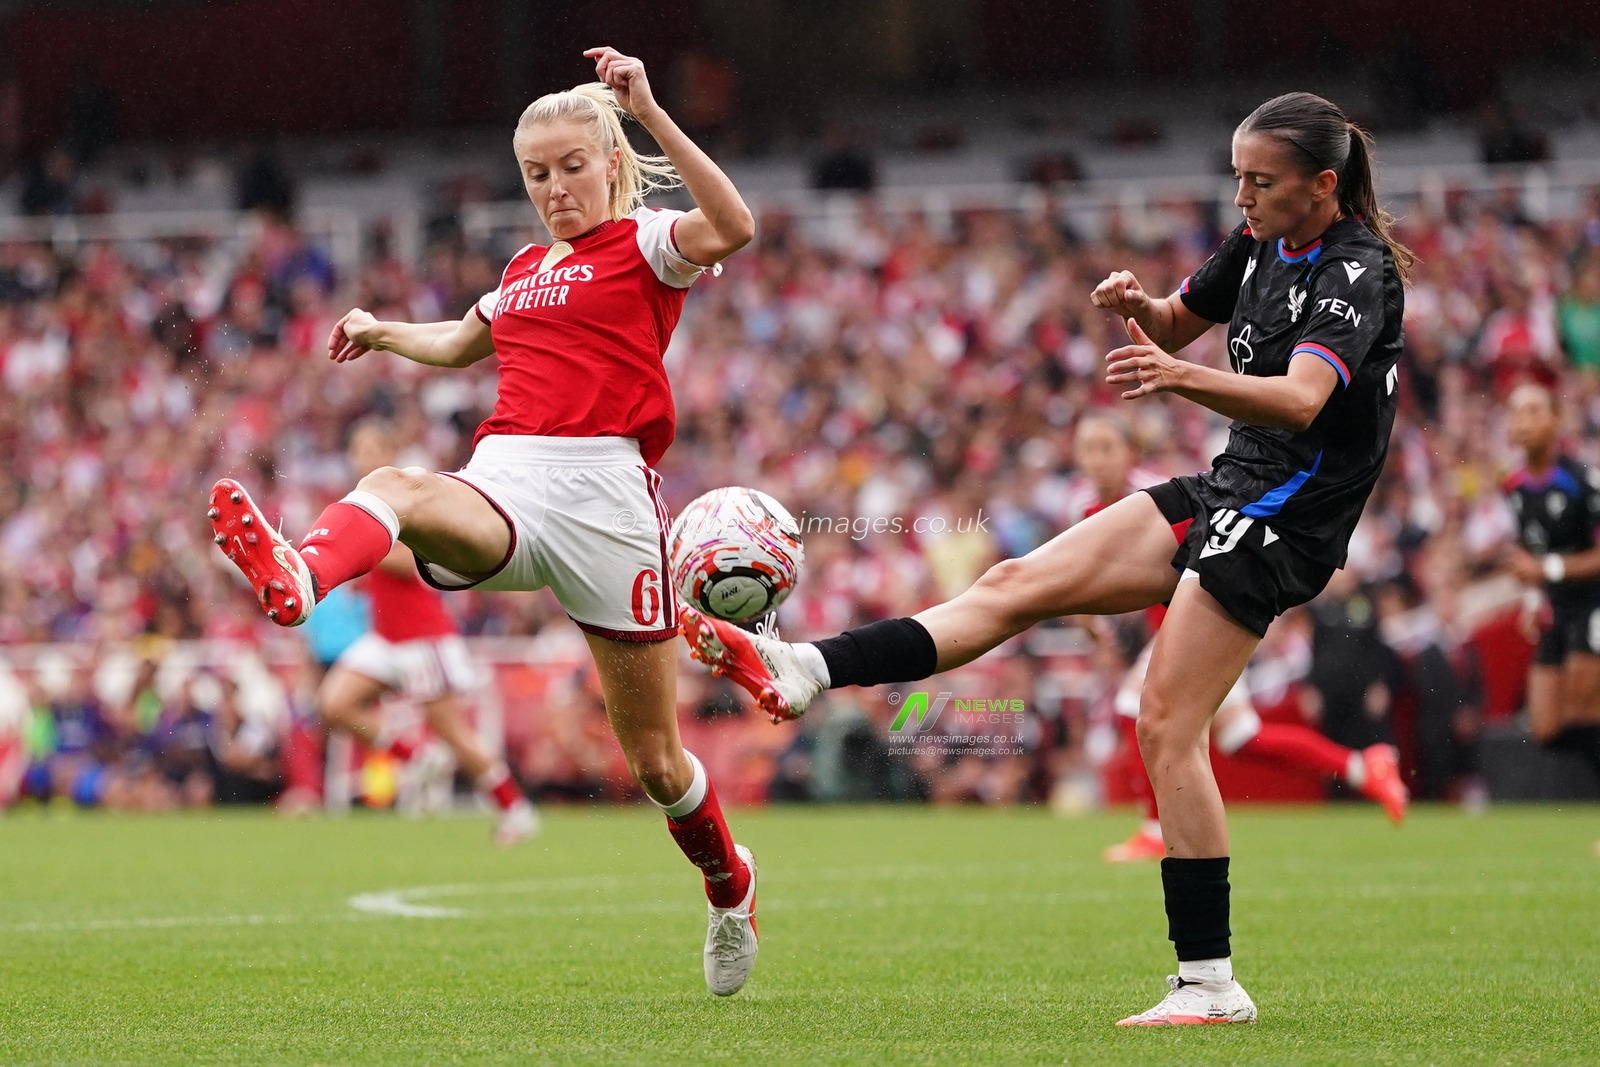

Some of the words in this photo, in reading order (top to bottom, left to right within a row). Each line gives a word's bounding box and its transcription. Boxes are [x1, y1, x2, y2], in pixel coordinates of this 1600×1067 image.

[500, 264, 594, 299] mirates
[515, 285, 570, 311] BETTER
[1318, 298, 1362, 328] TEN
[631, 568, 660, 626] 6
